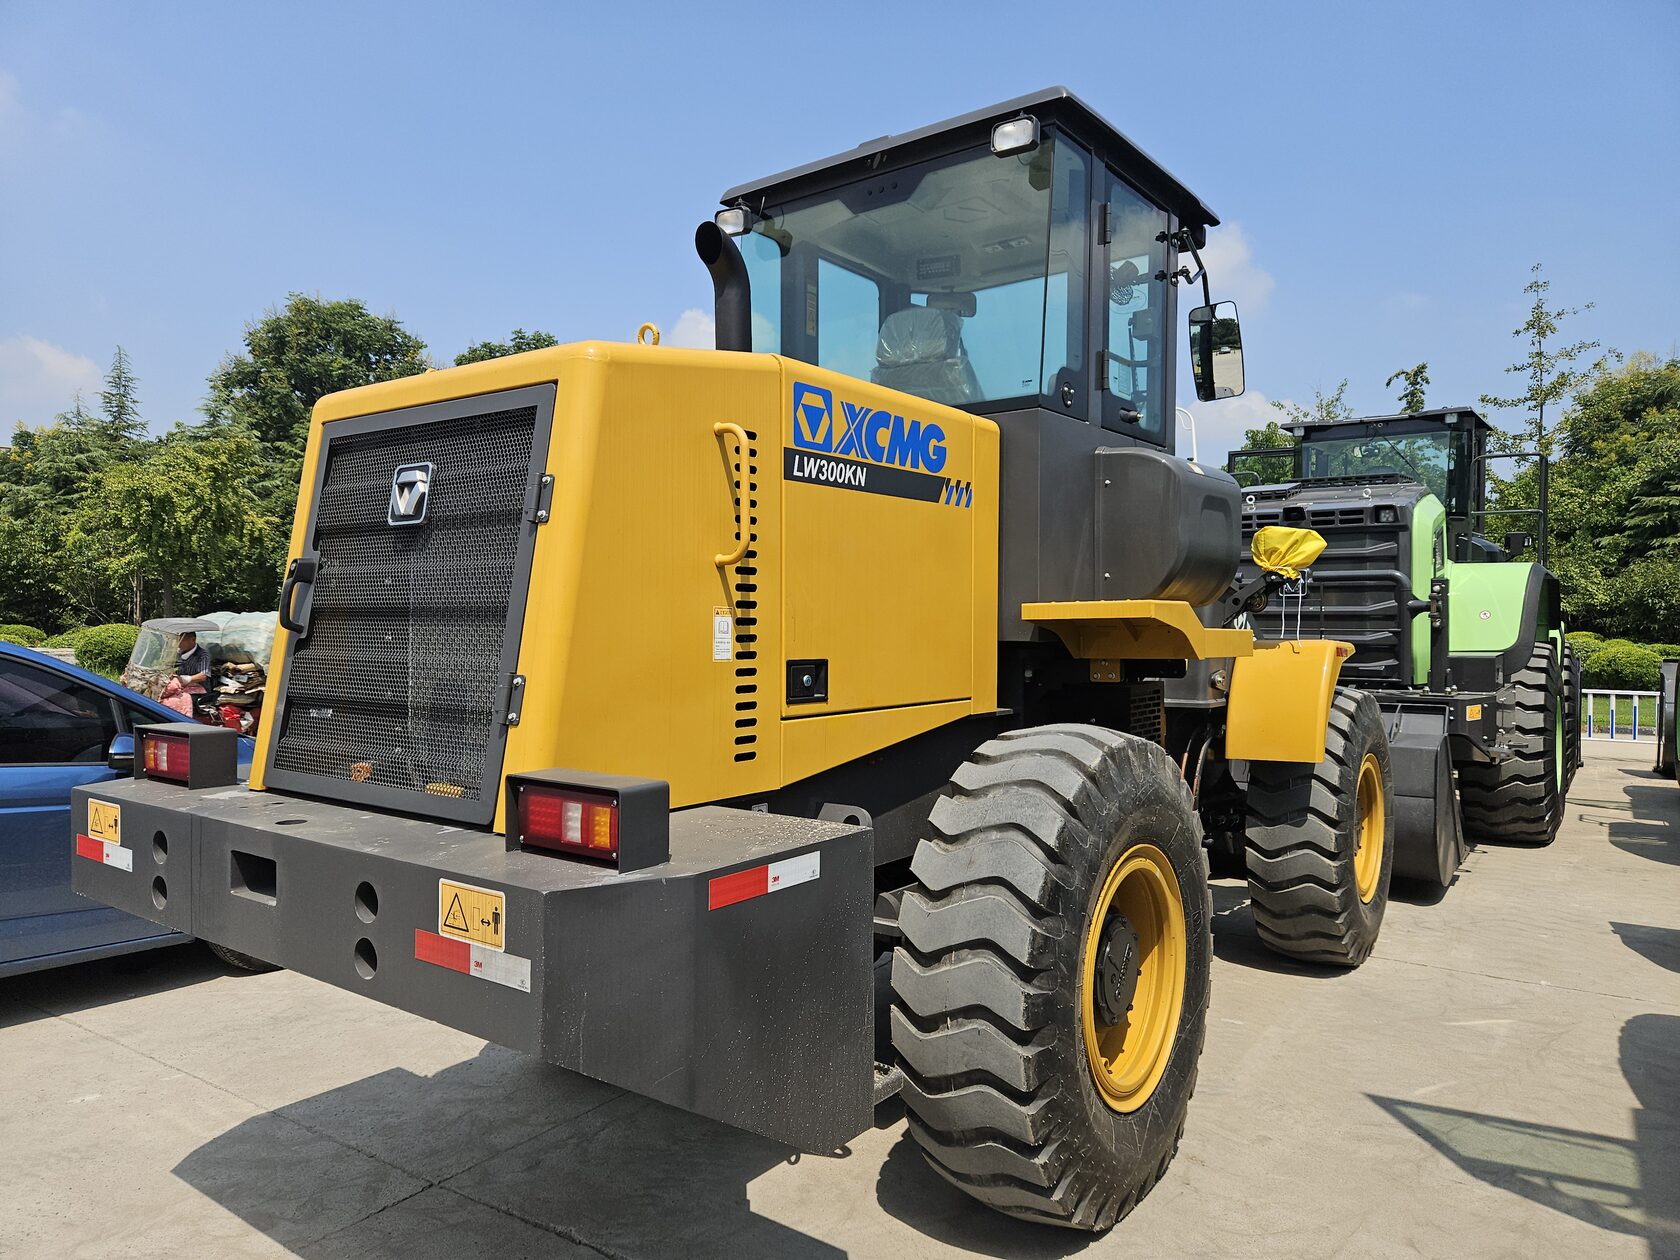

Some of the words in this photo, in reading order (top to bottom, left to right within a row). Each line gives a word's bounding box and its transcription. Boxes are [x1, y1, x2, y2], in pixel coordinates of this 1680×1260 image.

[832, 401, 947, 473] XCMG
[793, 454, 867, 487] LW300KN
[772, 875, 780, 883] 3M
[474, 960, 482, 968] 3M
